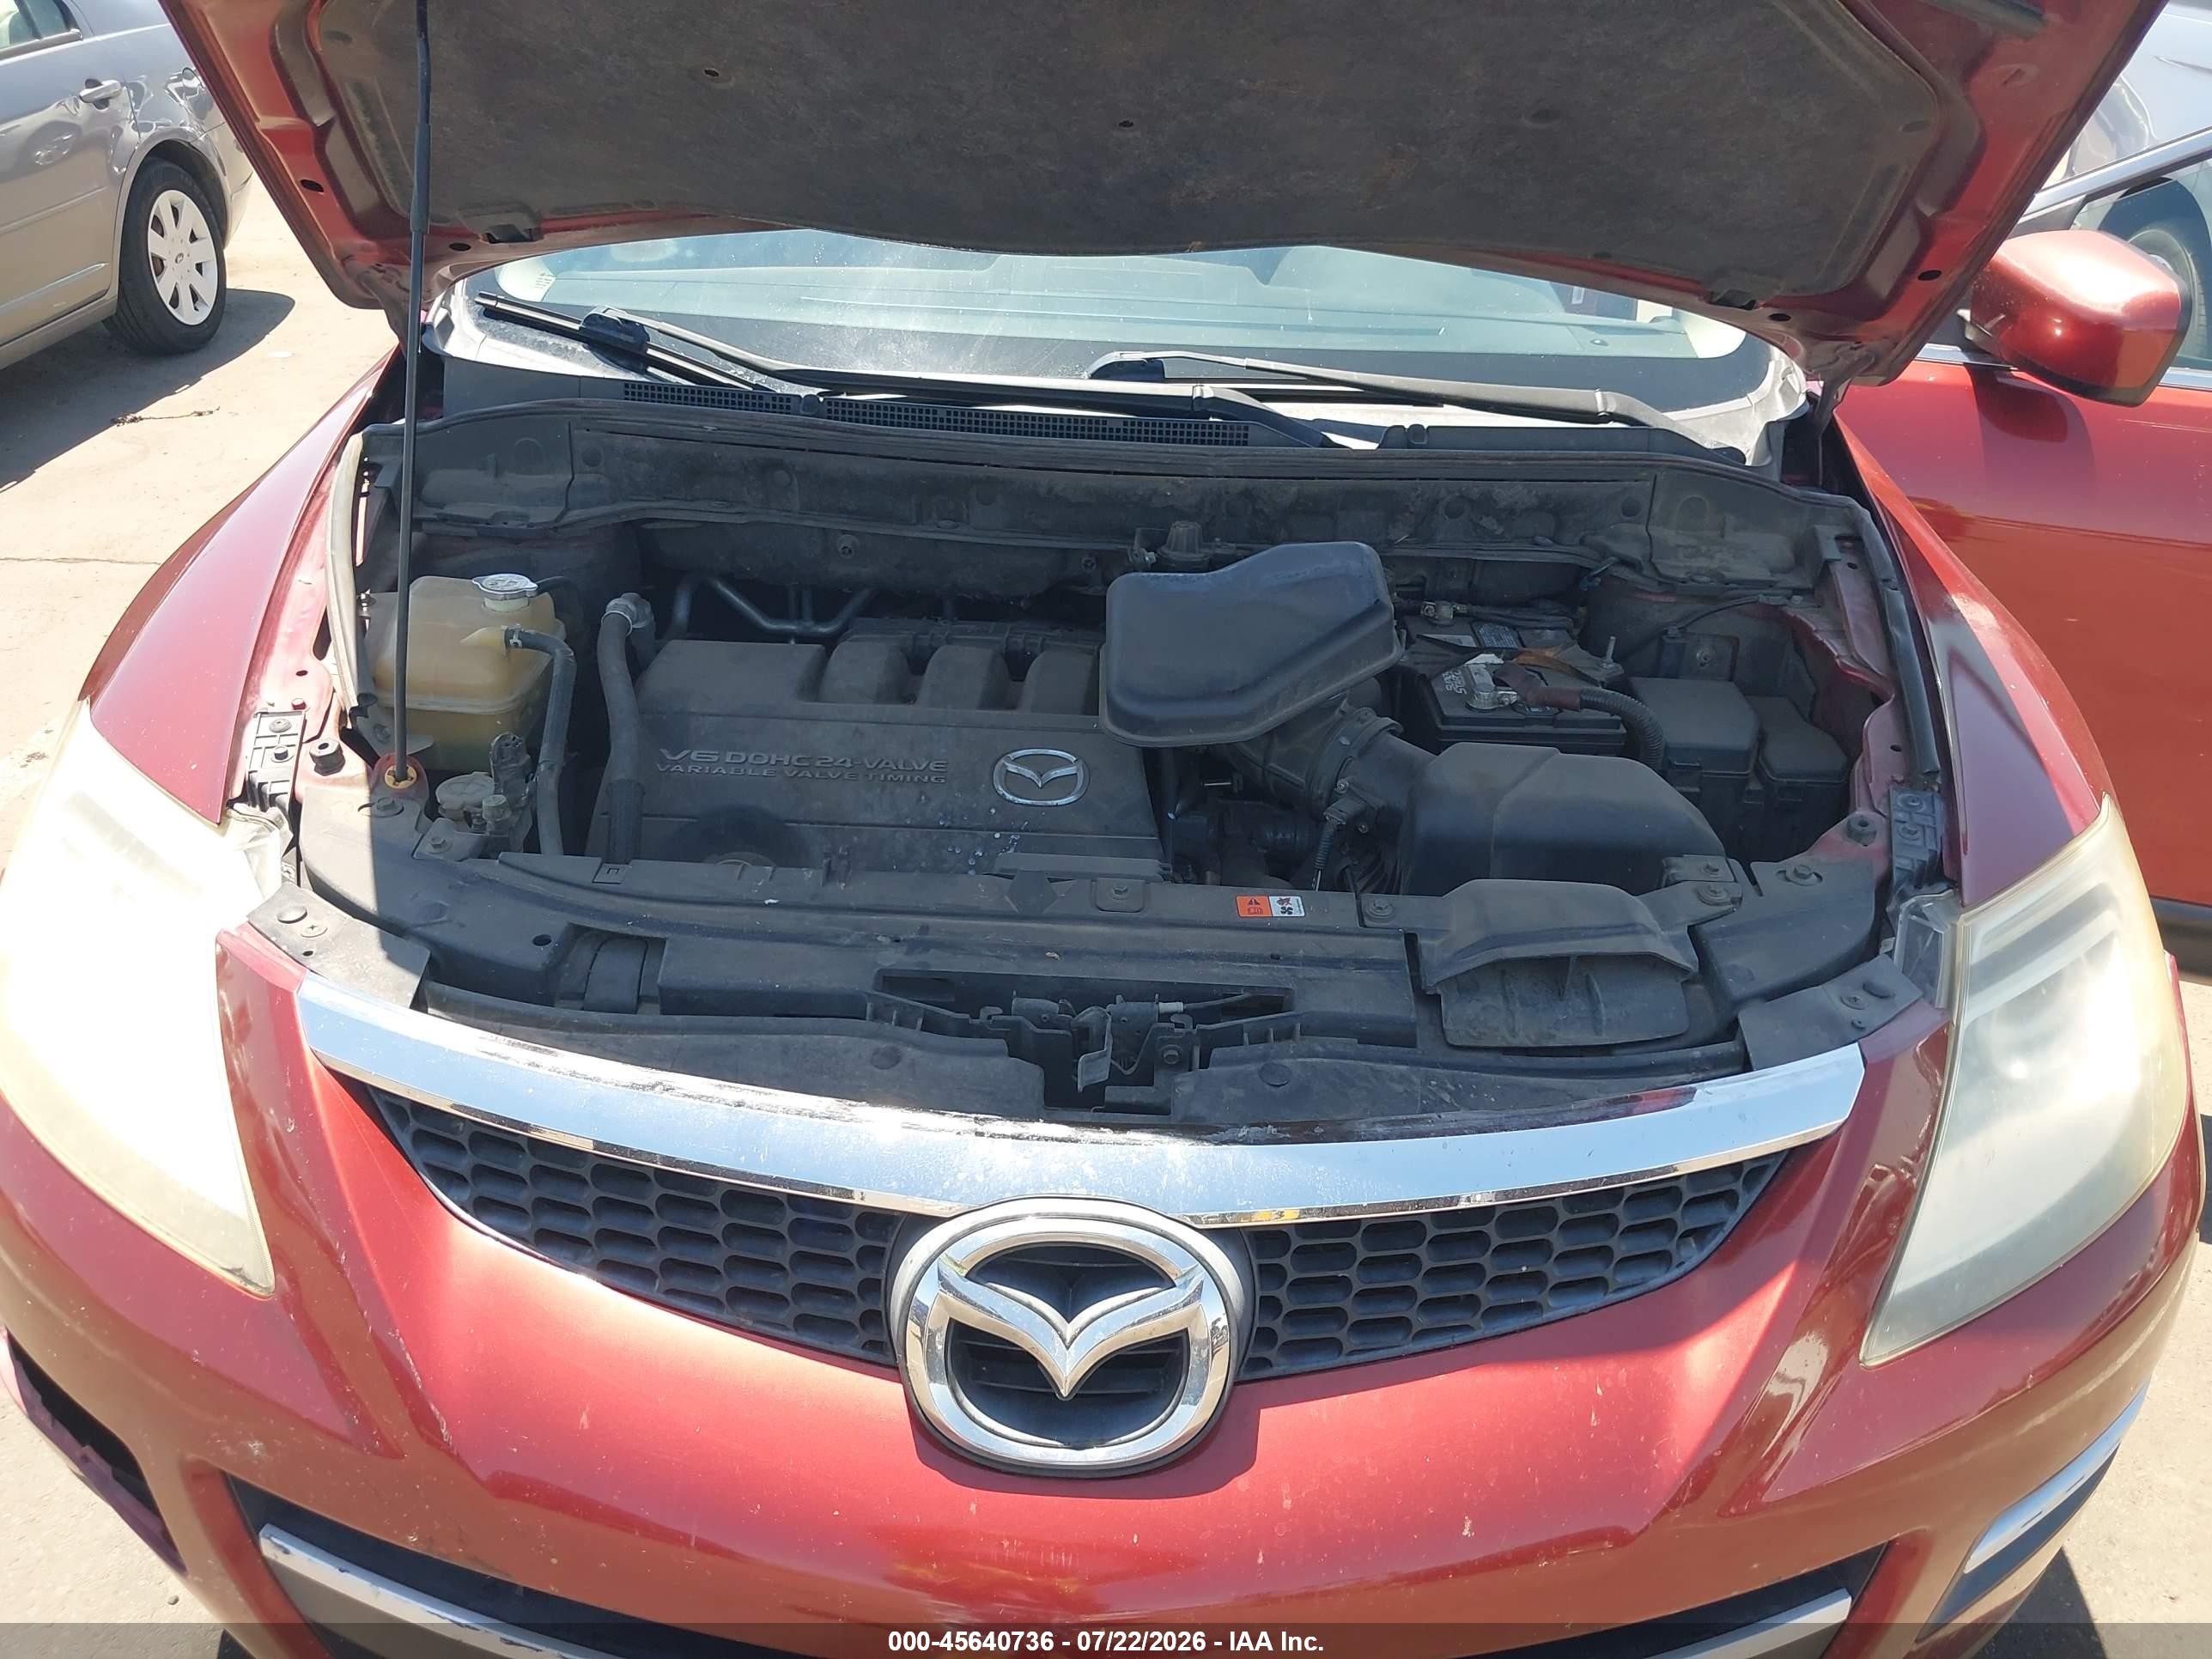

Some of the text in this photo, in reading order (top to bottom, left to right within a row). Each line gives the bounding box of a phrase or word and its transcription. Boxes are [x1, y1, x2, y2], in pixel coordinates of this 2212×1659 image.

[659, 748, 949, 772] V6 DOHC 24-VALVE
[657, 763, 947, 784] VARIABLE VALVE TIMING
